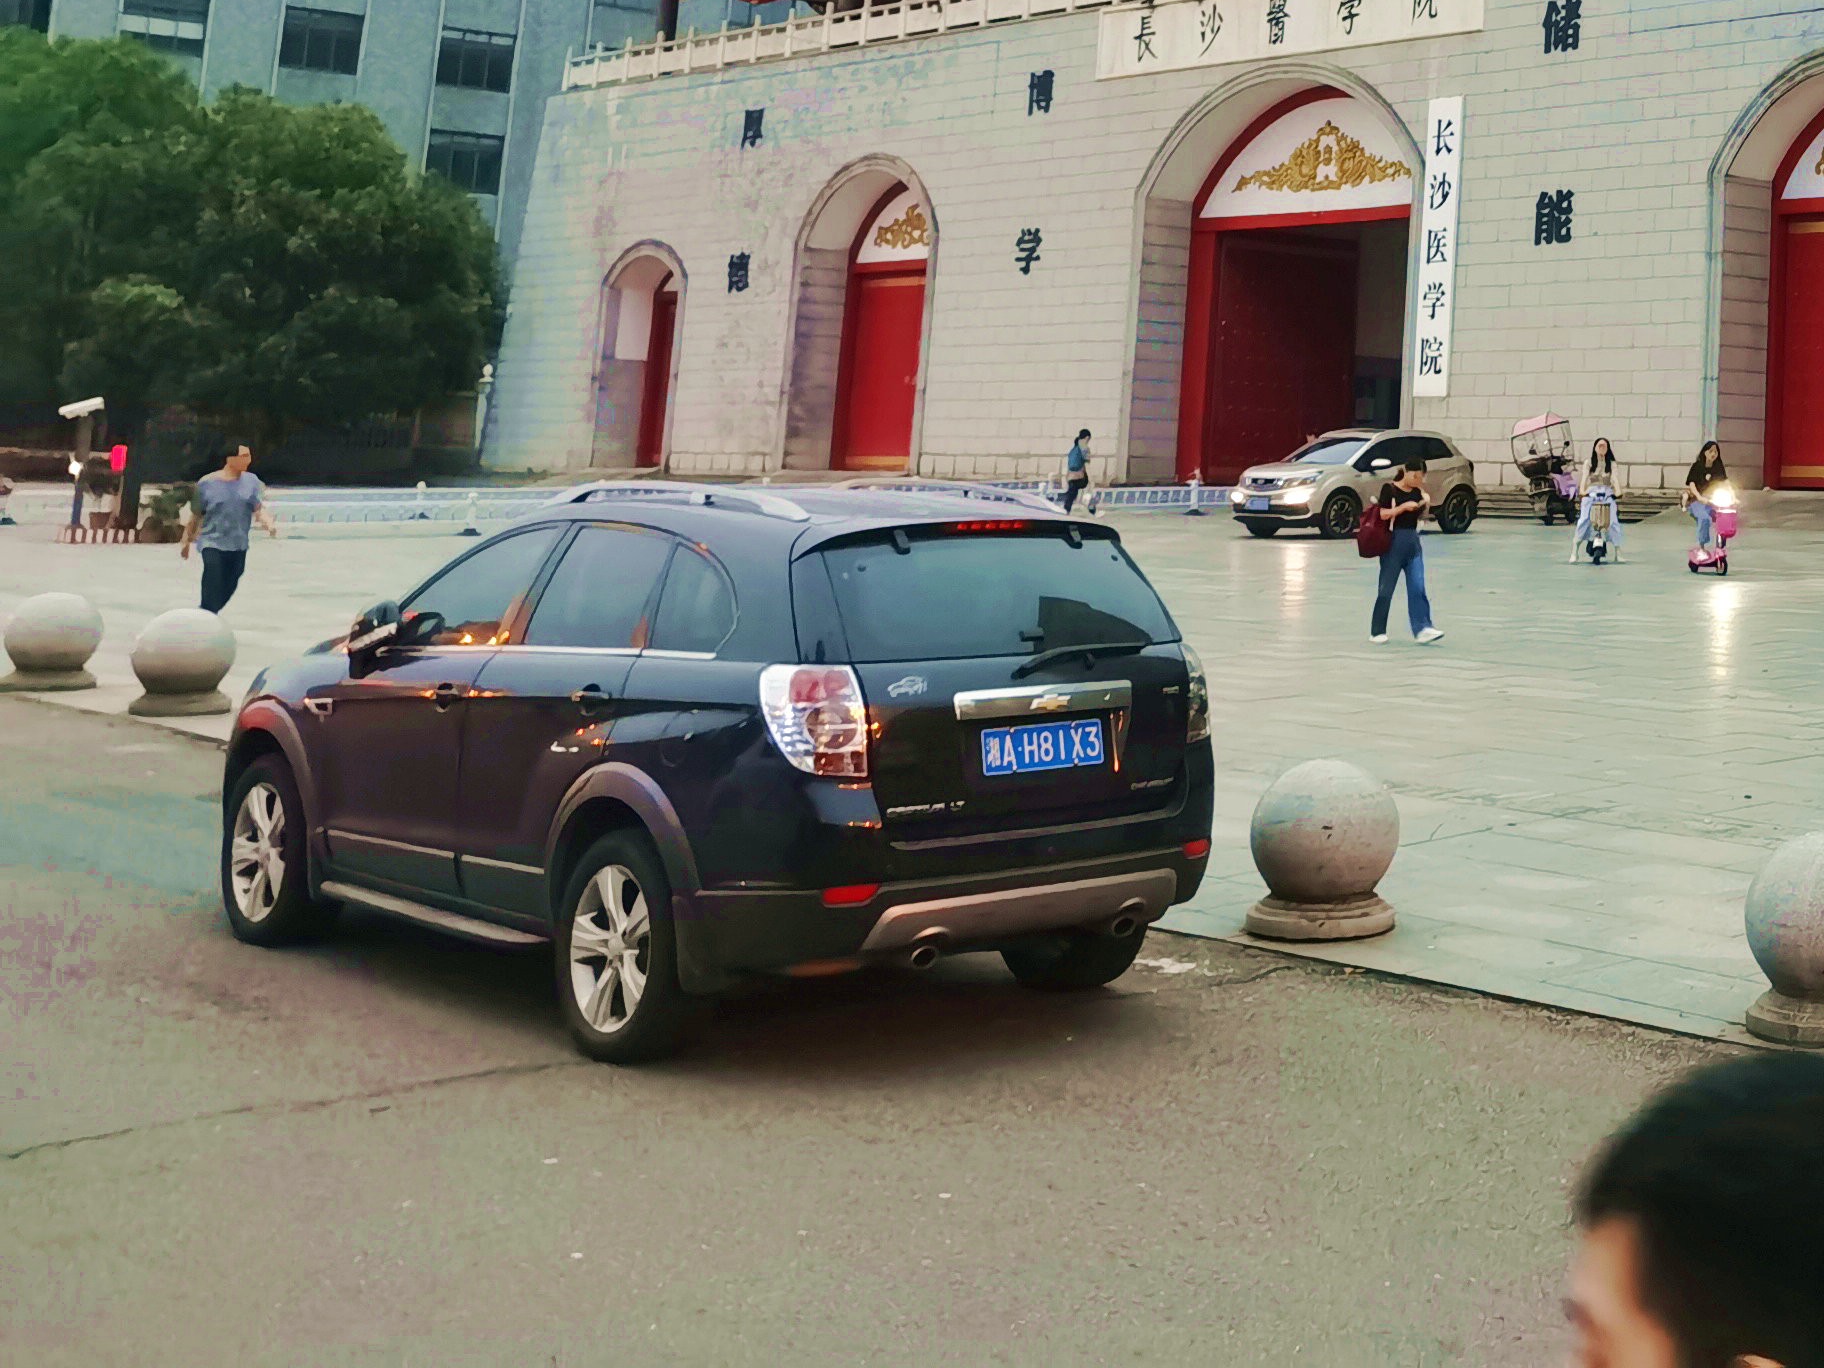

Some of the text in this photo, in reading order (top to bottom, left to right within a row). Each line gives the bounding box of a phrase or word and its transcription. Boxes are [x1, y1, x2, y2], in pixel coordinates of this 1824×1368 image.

[1418, 118, 1455, 376] 长沙医学院
